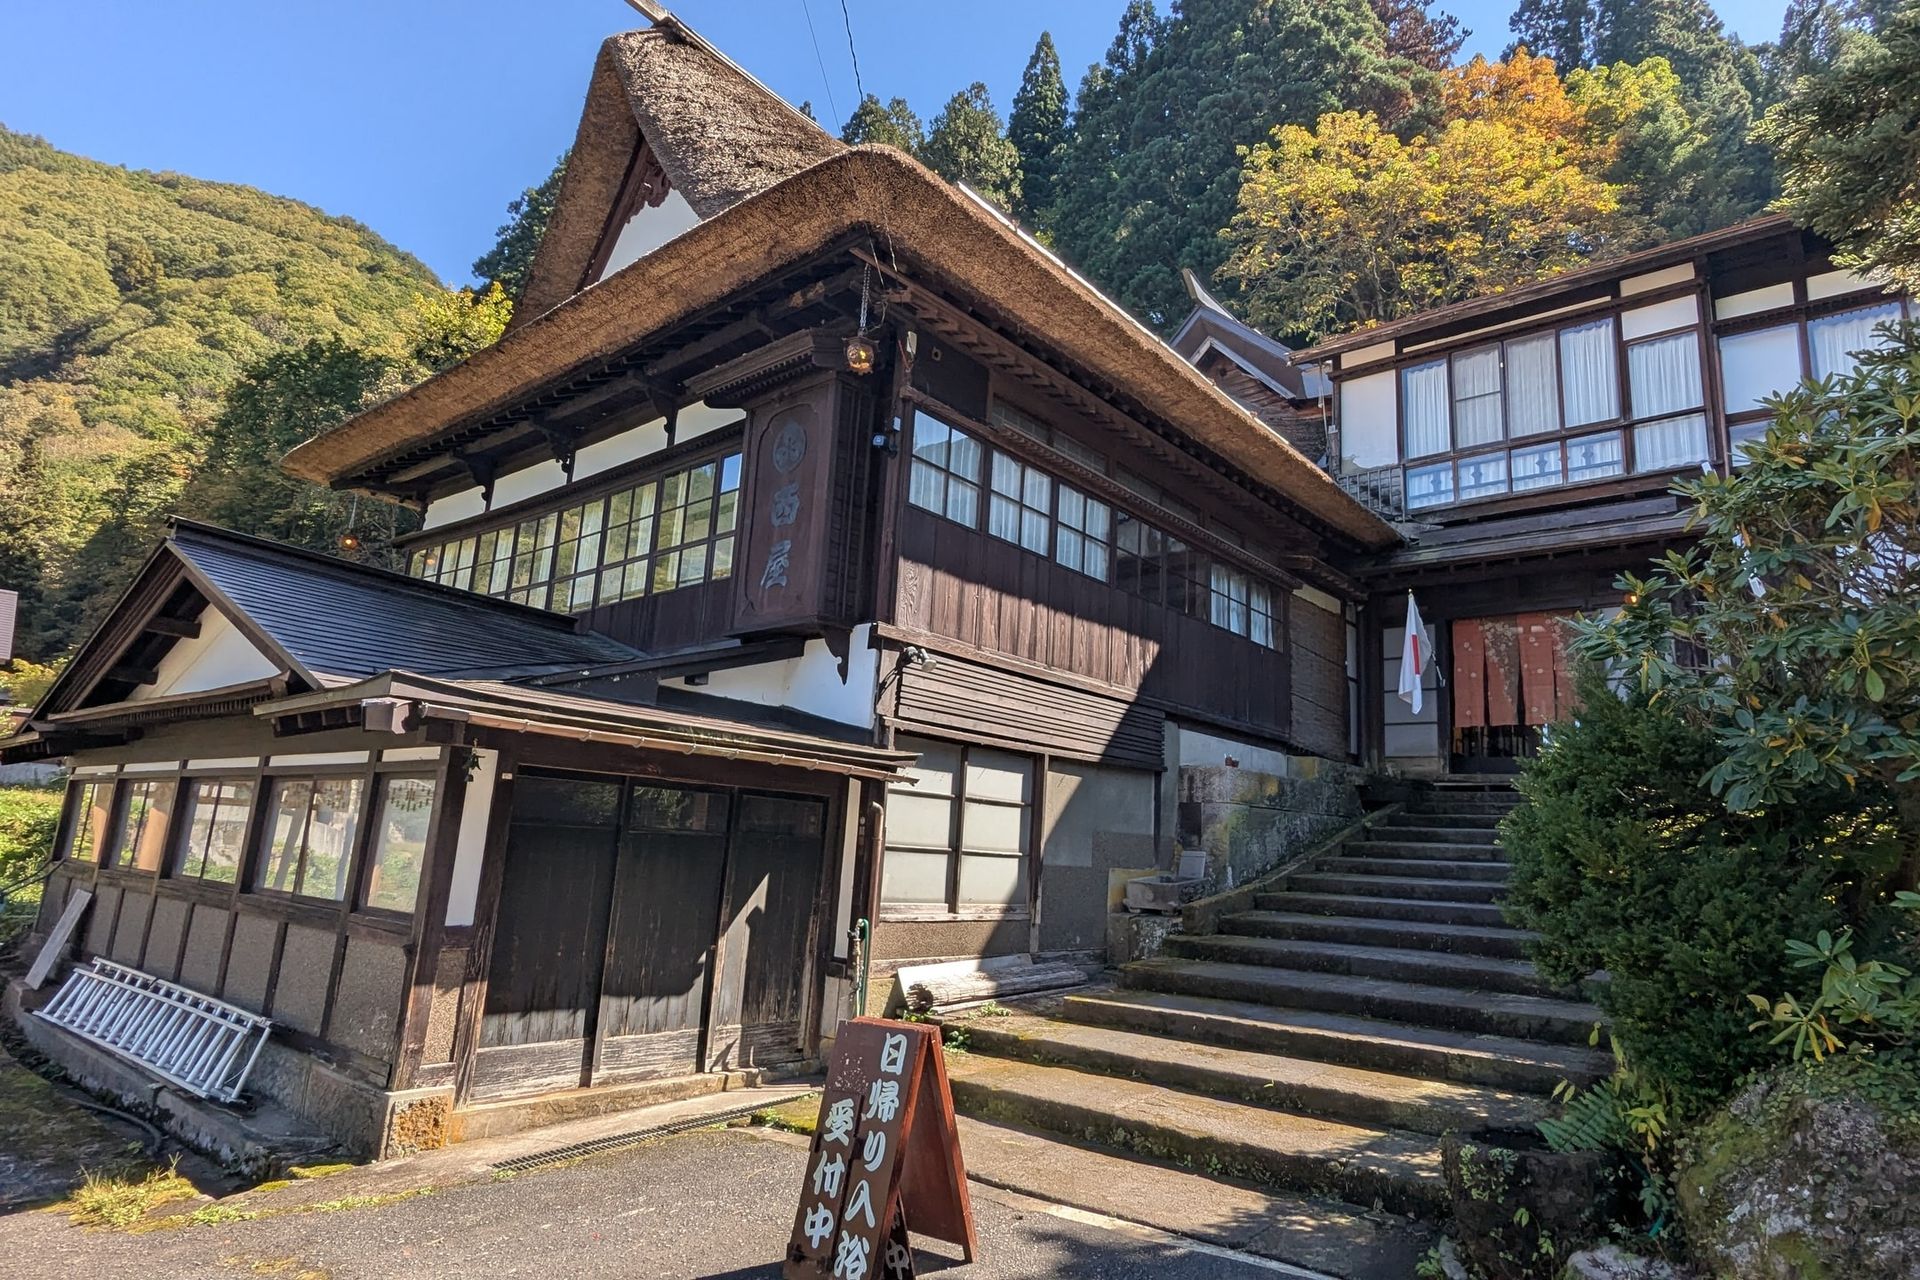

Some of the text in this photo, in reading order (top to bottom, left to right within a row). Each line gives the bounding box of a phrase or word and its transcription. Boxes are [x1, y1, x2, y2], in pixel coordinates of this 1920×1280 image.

[804, 1098, 854, 1249] 受付中
[834, 1032, 908, 1280] 日帰り入浴
